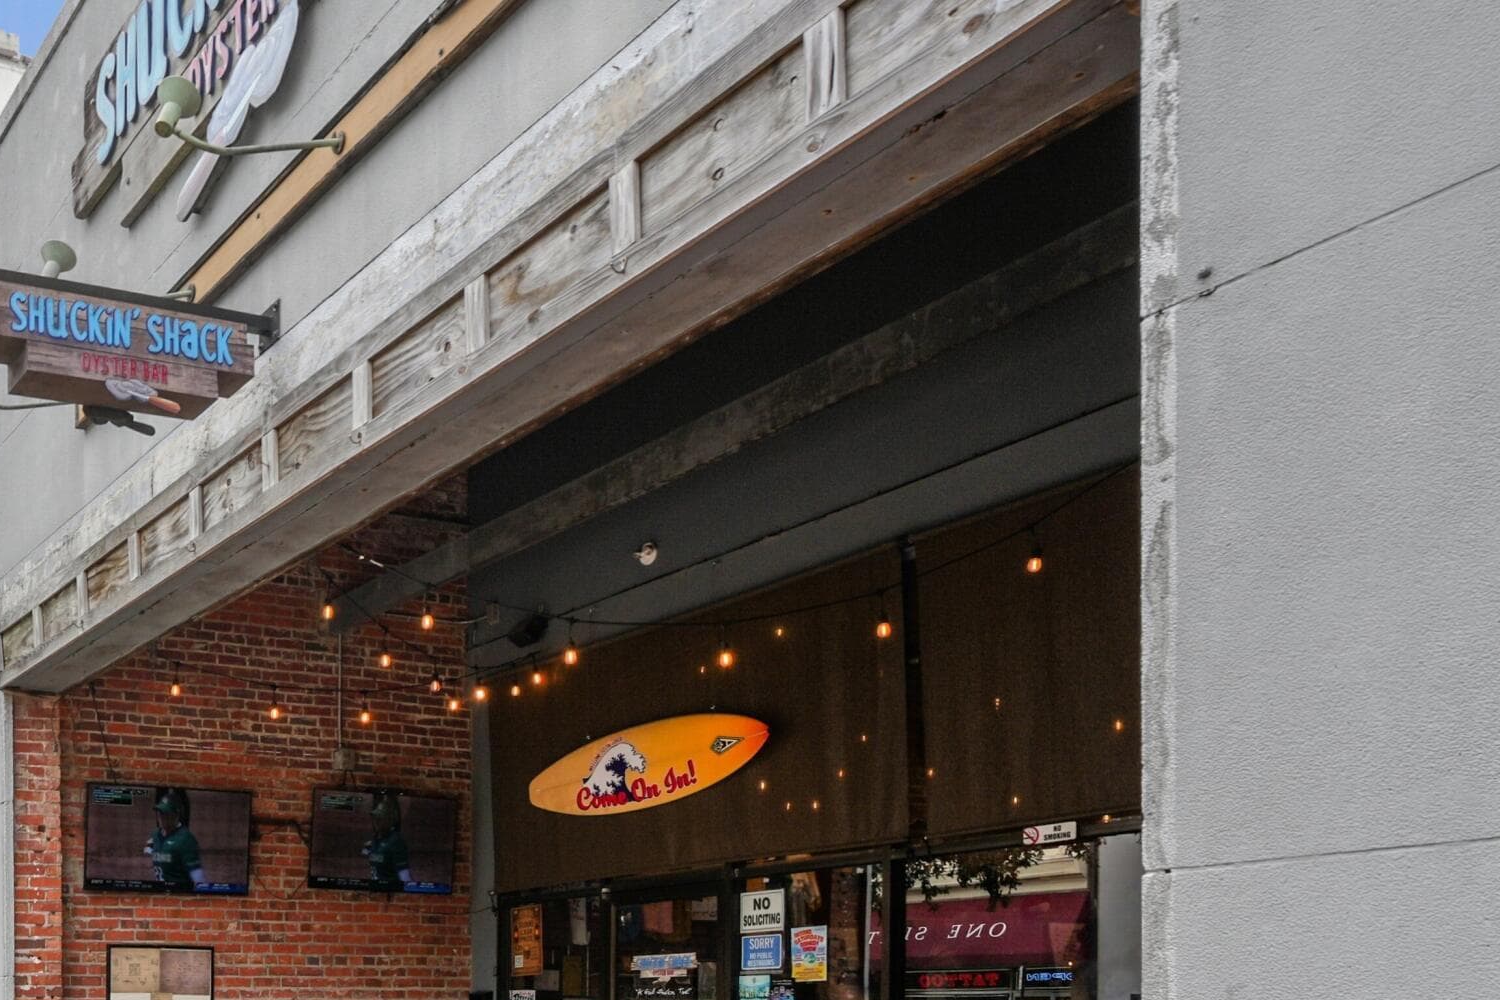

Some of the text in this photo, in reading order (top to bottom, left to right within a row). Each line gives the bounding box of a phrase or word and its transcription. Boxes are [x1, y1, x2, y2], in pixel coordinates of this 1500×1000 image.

[82, 352, 169, 385] OYSTER BAR
[576, 759, 698, 811] Come On In!
[1053, 824, 1062, 832] NO
[1043, 831, 1072, 841] SMOKING
[753, 897, 771, 911] NO
[743, 912, 781, 927] SOLICITING
[749, 938, 775, 950] SORRY
[756, 951, 773, 960] PUBLIC
